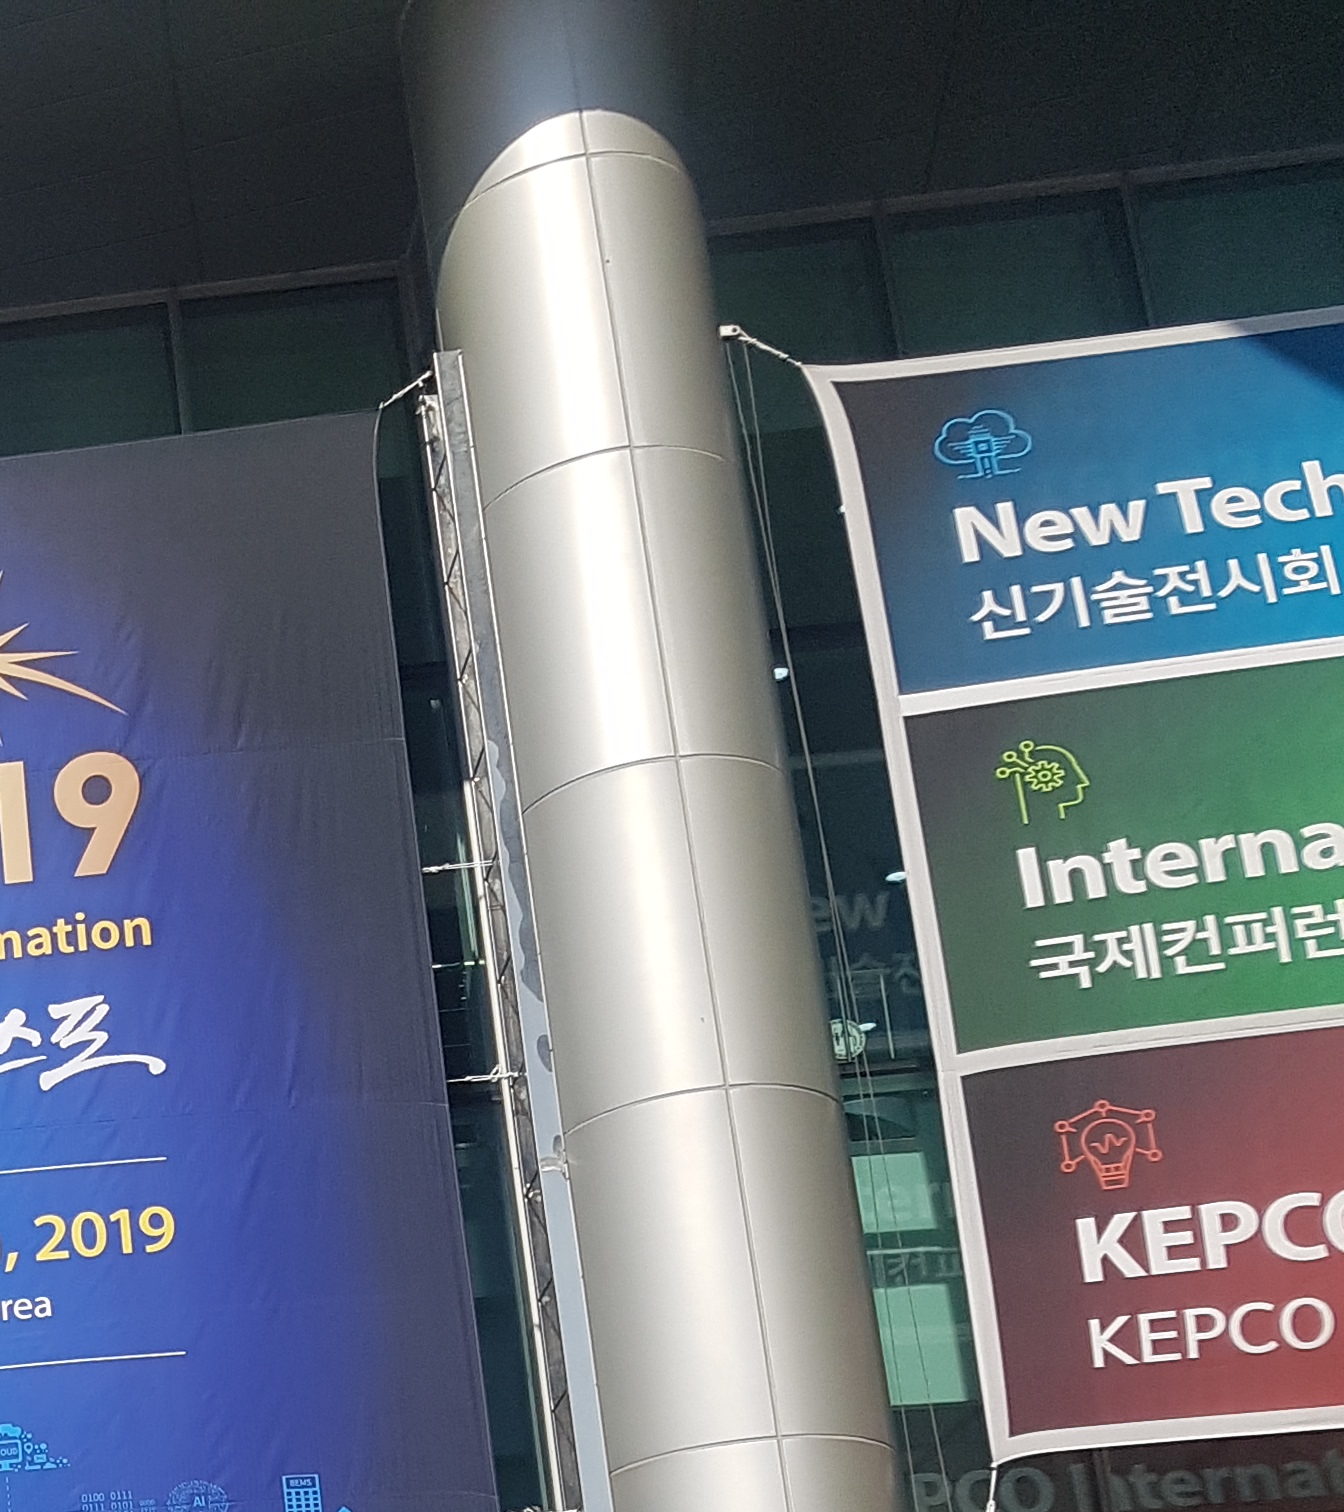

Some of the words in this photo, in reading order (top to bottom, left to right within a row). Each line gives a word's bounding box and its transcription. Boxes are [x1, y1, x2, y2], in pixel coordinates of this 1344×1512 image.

[951, 498, 1147, 564] New
[1155, 459, 1344, 536] Tech
[968, 544, 1341, 641] 신기술전시회
[1014, 822, 1344, 908] Interna
[33, 1205, 176, 1264] 2019
[1087, 1297, 1336, 1369] KEPCO
[110, 1490, 133, 1500] 0111
[193, 1496, 206, 1507] AI
